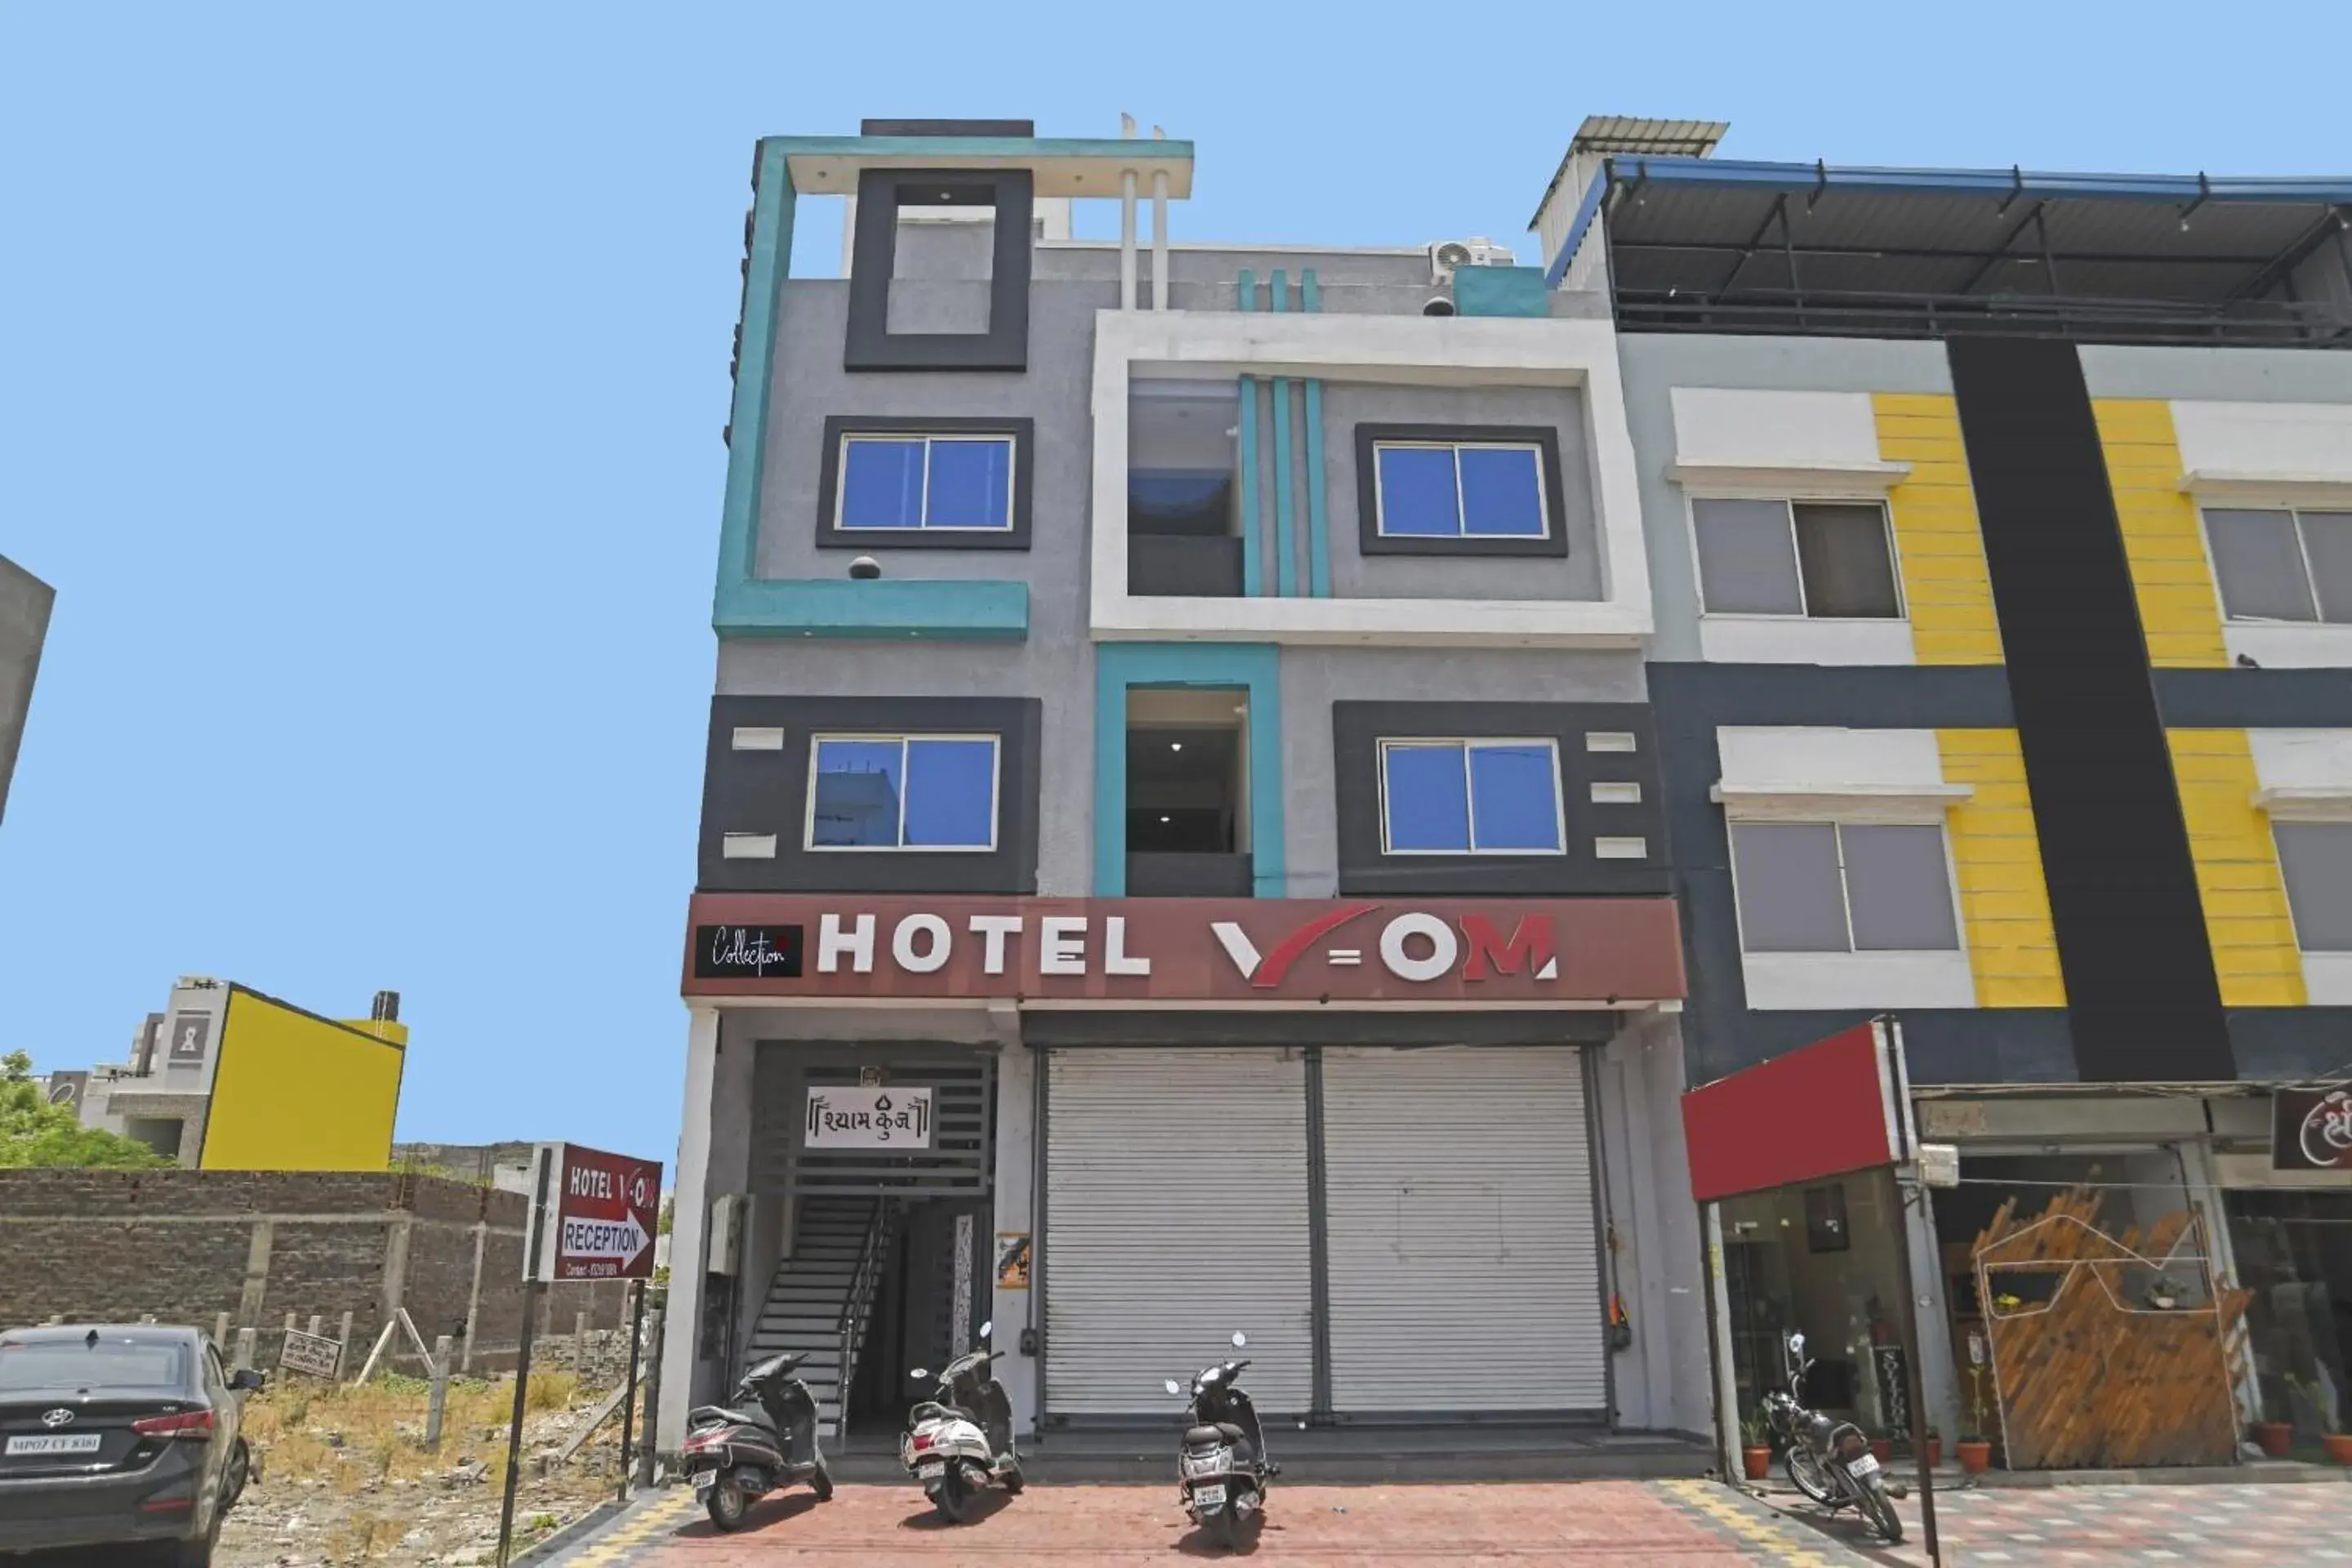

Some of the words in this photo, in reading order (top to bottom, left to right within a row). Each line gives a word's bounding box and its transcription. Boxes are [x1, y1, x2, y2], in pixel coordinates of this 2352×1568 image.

[712, 925, 785, 978] Collection
[817, 913, 1151, 974] HOTEL
[824, 1111, 871, 1132] श्याम
[569, 1166, 613, 1200] HOTEL
[564, 1224, 639, 1252] RECEPTION
